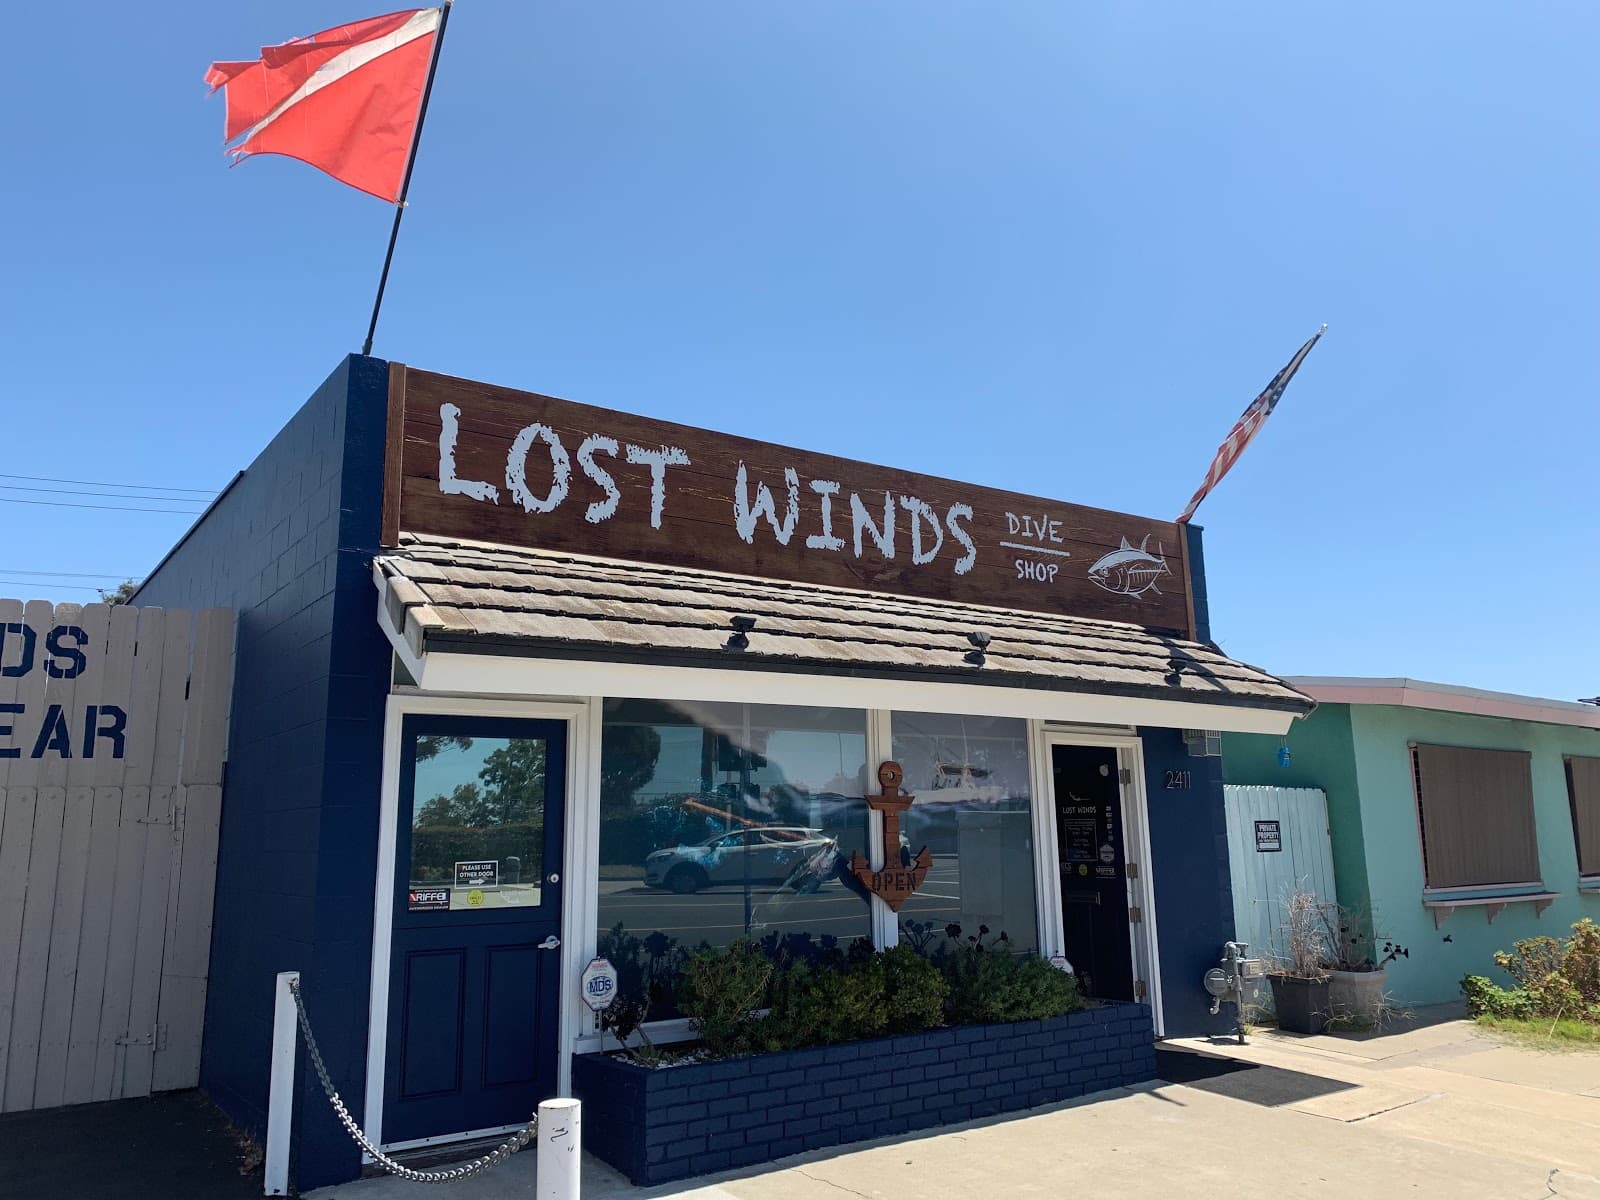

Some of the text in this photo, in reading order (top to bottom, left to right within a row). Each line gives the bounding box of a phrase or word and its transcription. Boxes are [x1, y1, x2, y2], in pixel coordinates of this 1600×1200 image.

[438, 402, 976, 576] LOST WINDS
[1005, 511, 1064, 543] DIVE
[1015, 558, 1059, 584] SHOP
[1166, 770, 1192, 790] 2411
[872, 872, 915, 891] OPEN
[589, 981, 611, 992] MDS
